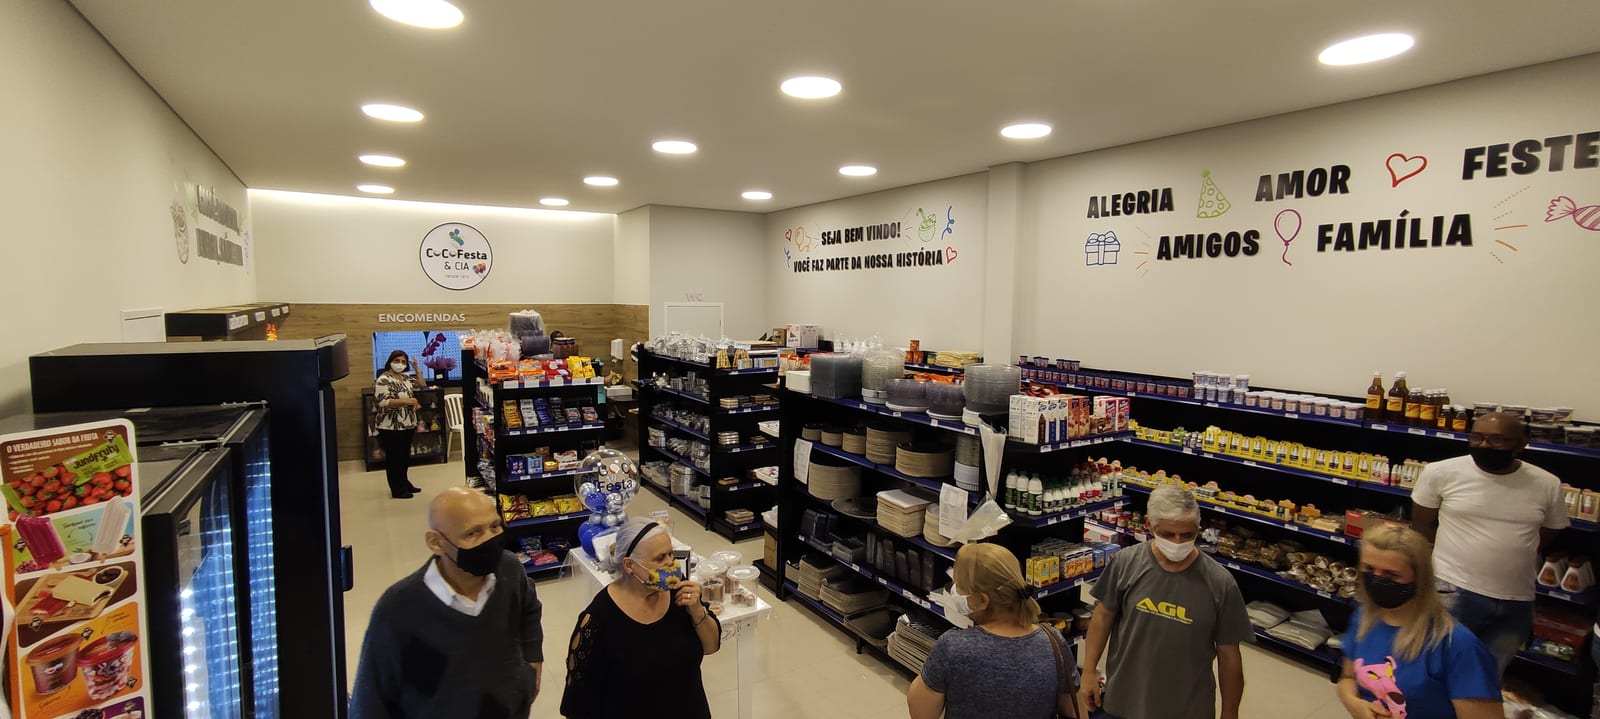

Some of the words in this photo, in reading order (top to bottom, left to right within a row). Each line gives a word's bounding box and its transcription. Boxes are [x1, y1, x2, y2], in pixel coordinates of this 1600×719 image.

[1087, 188, 1174, 219] ALEGRIA
[1255, 165, 1351, 201] AMOR
[1462, 130, 1600, 180] FESTE
[821, 229, 842, 246] SEJA
[844, 226, 864, 243] BEM
[866, 222, 901, 241] VINDO!
[1156, 230, 1260, 260] AMIGOS
[1317, 210, 1473, 252] FAMÍLIA
[455, 261, 470, 271] CIA
[794, 257, 810, 273] VOCÊ
[812, 259, 824, 272] FAZ
[826, 257, 849, 271] PARTE
[851, 255, 862, 270] DA
[864, 254, 893, 269] NOSSA
[896, 247, 943, 268] HISTÓRIA
[378, 313, 466, 323] ENCOMENDAS
[6, 445, 12, 453] O
[13, 440, 52, 452] VERDADEIRO
[1136, 597, 1193, 622] AGL
